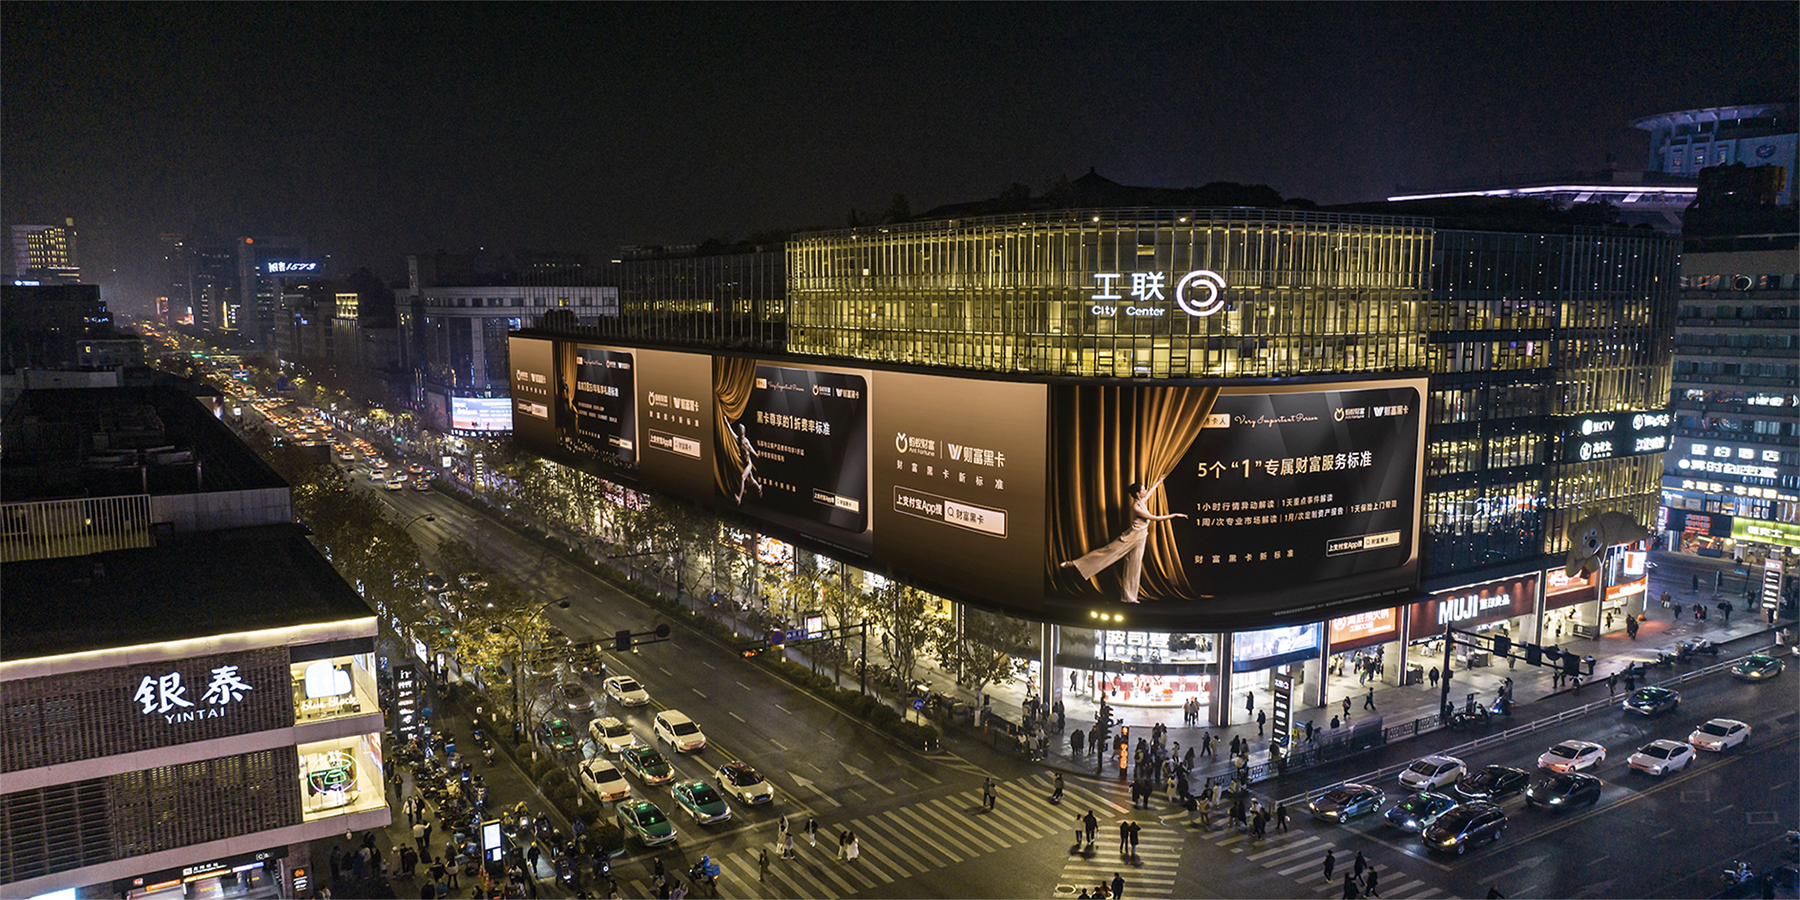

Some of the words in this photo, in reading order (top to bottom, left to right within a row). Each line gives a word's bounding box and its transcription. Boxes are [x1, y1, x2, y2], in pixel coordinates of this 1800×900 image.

[1091, 271, 1165, 301] 工联
[1091, 305, 1117, 317] City
[1125, 306, 1165, 316] Center
[756, 410, 831, 436] 黑卡尊享的1折费率标准
[1234, 414, 1256, 428] Very
[1257, 414, 1295, 427] Important
[1295, 412, 1318, 423] Person
[909, 436, 935, 451] 蚂蚁财富
[963, 446, 1005, 468] 财富黑卡
[896, 459, 1004, 490] 财富黑卡新标准
[896, 494, 943, 516] 上支付宝App搜
[956, 509, 984, 525] 财富黑卡
[1196, 499, 1275, 512] 1小时行情异动解读
[1282, 493, 1334, 508] 1天重点事件解读
[1196, 515, 1278, 527] 1周/次专业市场解读
[1194, 549, 1294, 564] 财富黑卡新标准
[1347, 608, 1389, 626] 海底捞火锅
[1438, 594, 1478, 625] MUJI
[1106, 630, 1171, 648] 波司登
[133, 664, 253, 716] 银泰
[165, 707, 225, 725] YINTAI
